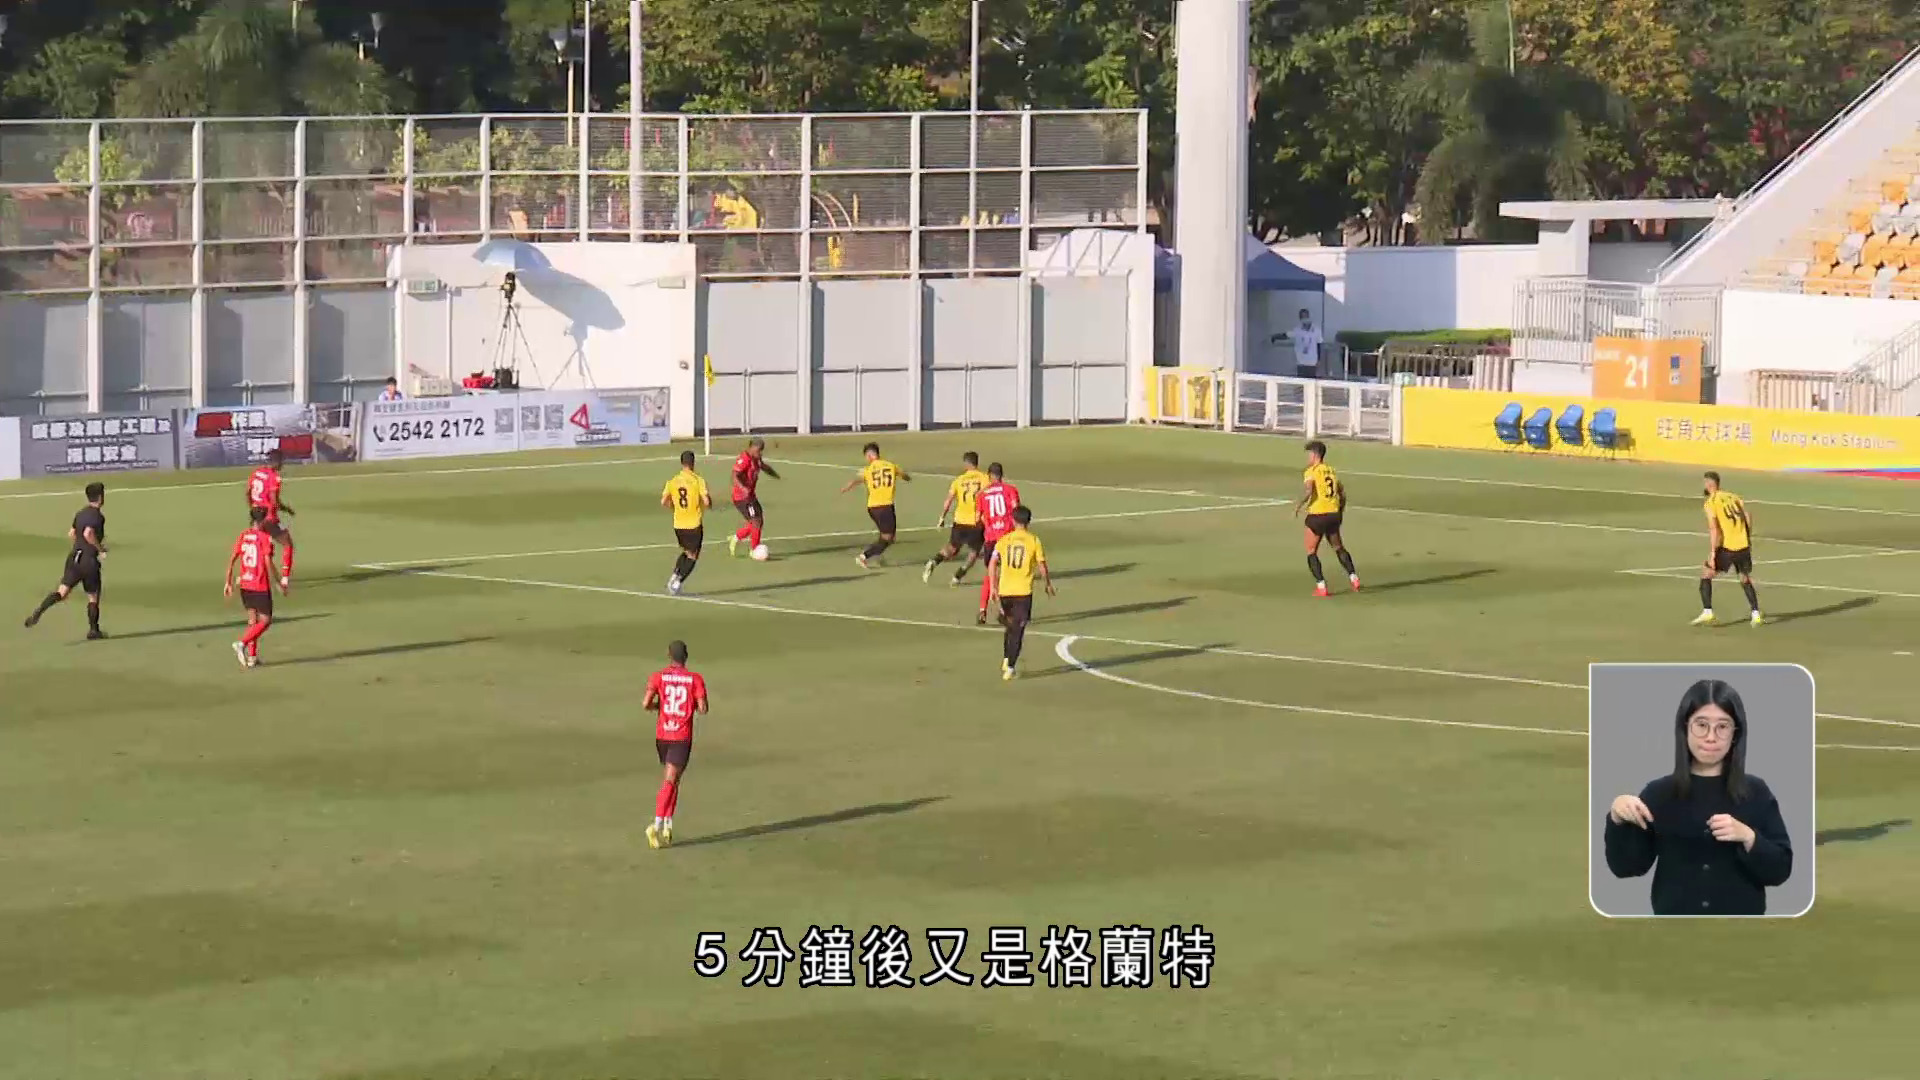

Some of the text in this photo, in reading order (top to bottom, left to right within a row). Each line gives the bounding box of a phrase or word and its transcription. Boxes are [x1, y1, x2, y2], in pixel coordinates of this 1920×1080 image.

[1624, 355, 1648, 389] 21
[389, 416, 485, 442] 2542 2172
[1656, 418, 1752, 444] 旺角大球場
[1771, 429, 1807, 447] Mong
[1812, 434, 1837, 446] Kok
[871, 468, 893, 490] 55
[1324, 476, 1334, 498] 3
[677, 486, 688, 508] 8
[984, 494, 1007, 518] 70
[1006, 543, 1026, 569] 10
[663, 684, 688, 717] 32
